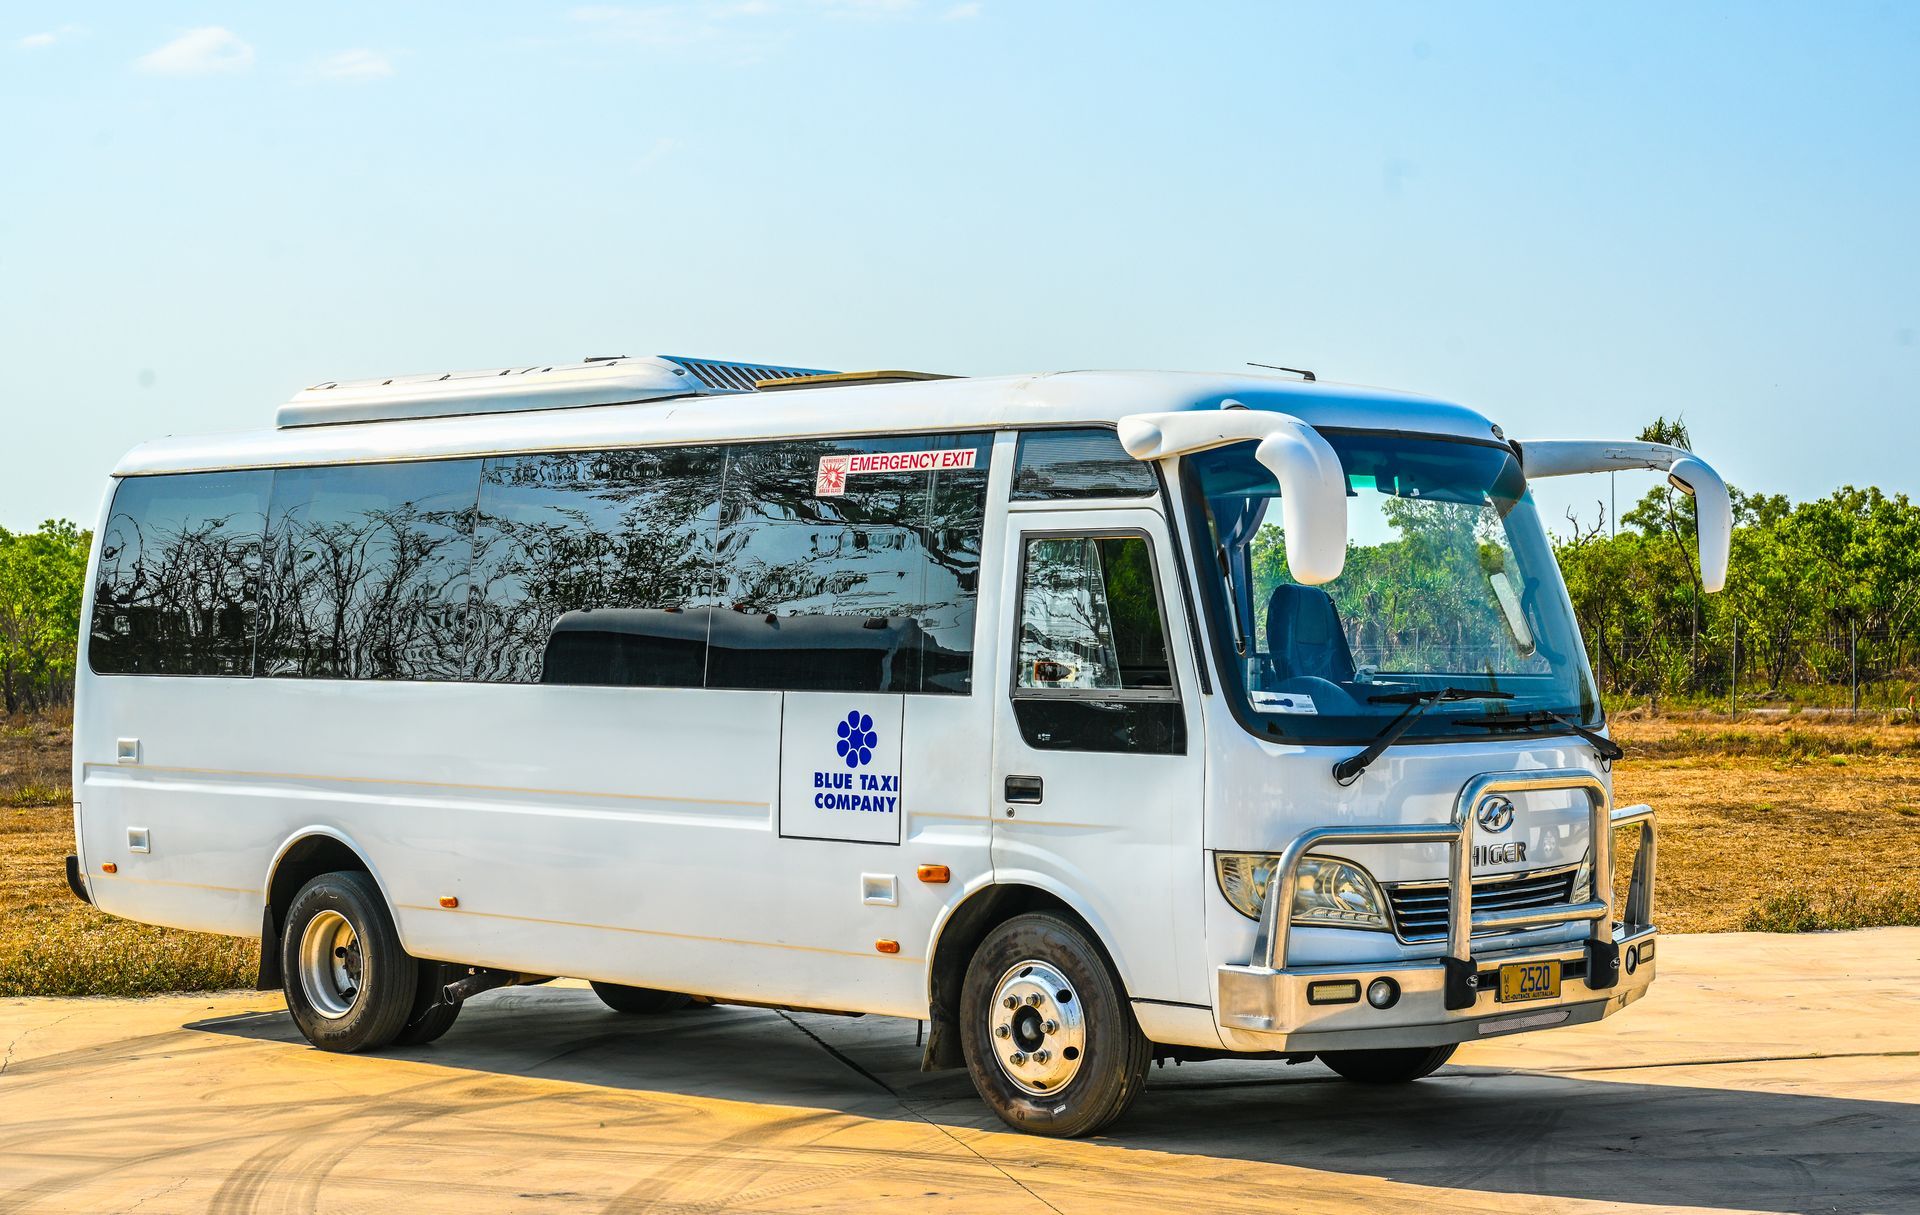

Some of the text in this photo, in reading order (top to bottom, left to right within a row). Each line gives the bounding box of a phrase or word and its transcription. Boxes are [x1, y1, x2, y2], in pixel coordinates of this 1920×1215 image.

[850, 451, 974, 471] EMERGENCY EXIT
[814, 772, 899, 792] BLUE TAXI
[814, 793, 897, 813] COMPANY
[1520, 965, 1550, 993] 2520
